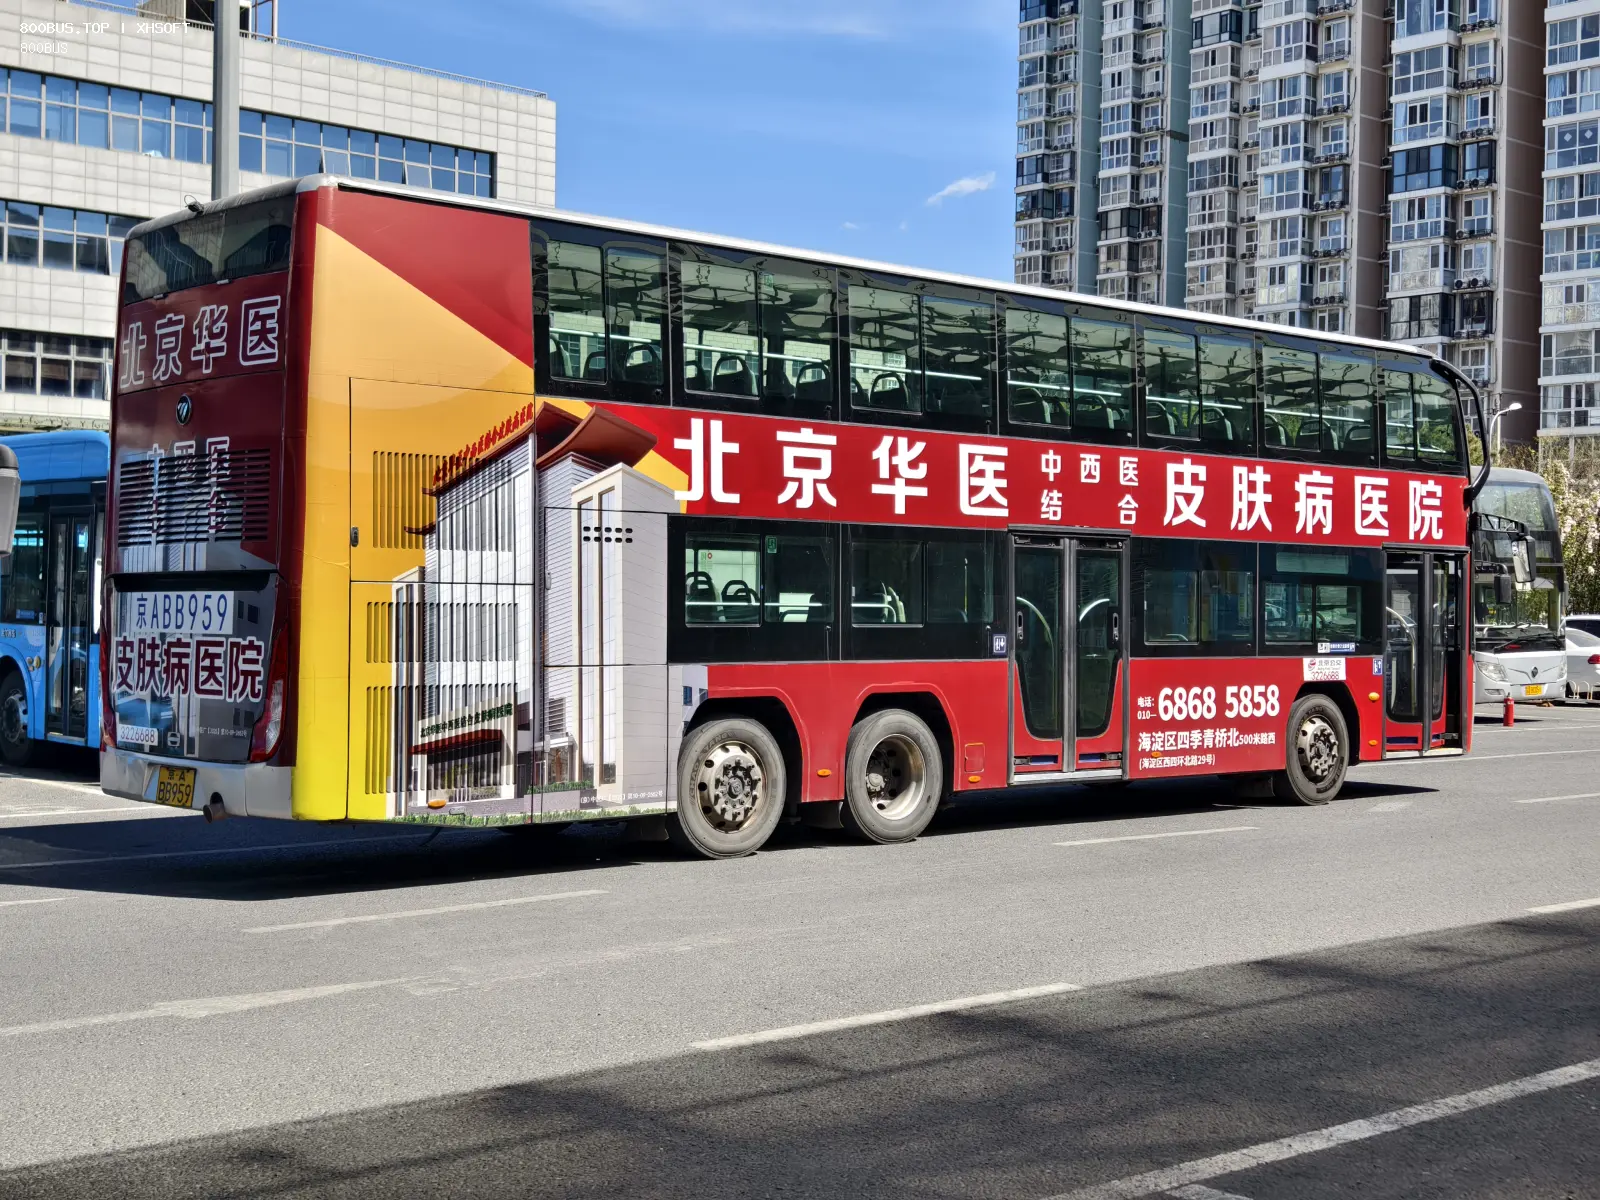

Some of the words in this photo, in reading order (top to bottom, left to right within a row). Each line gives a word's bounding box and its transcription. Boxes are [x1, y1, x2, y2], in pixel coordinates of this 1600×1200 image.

[119, 295, 281, 389] 北京华医
[673, 417, 1009, 518] 北京华医
[1040, 449, 1139, 487] 中西医
[1040, 489, 1139, 526] 结合
[1163, 458, 1443, 541] 皮肤病医院
[136, 593, 229, 632] 京ABB959
[113, 636, 265, 702] 皮肤病医院
[1158, 686, 1217, 721] 6868
[1224, 684, 1280, 719] 5858
[120, 726, 156, 744] 3226688
[158, 782, 191, 804] BB959
